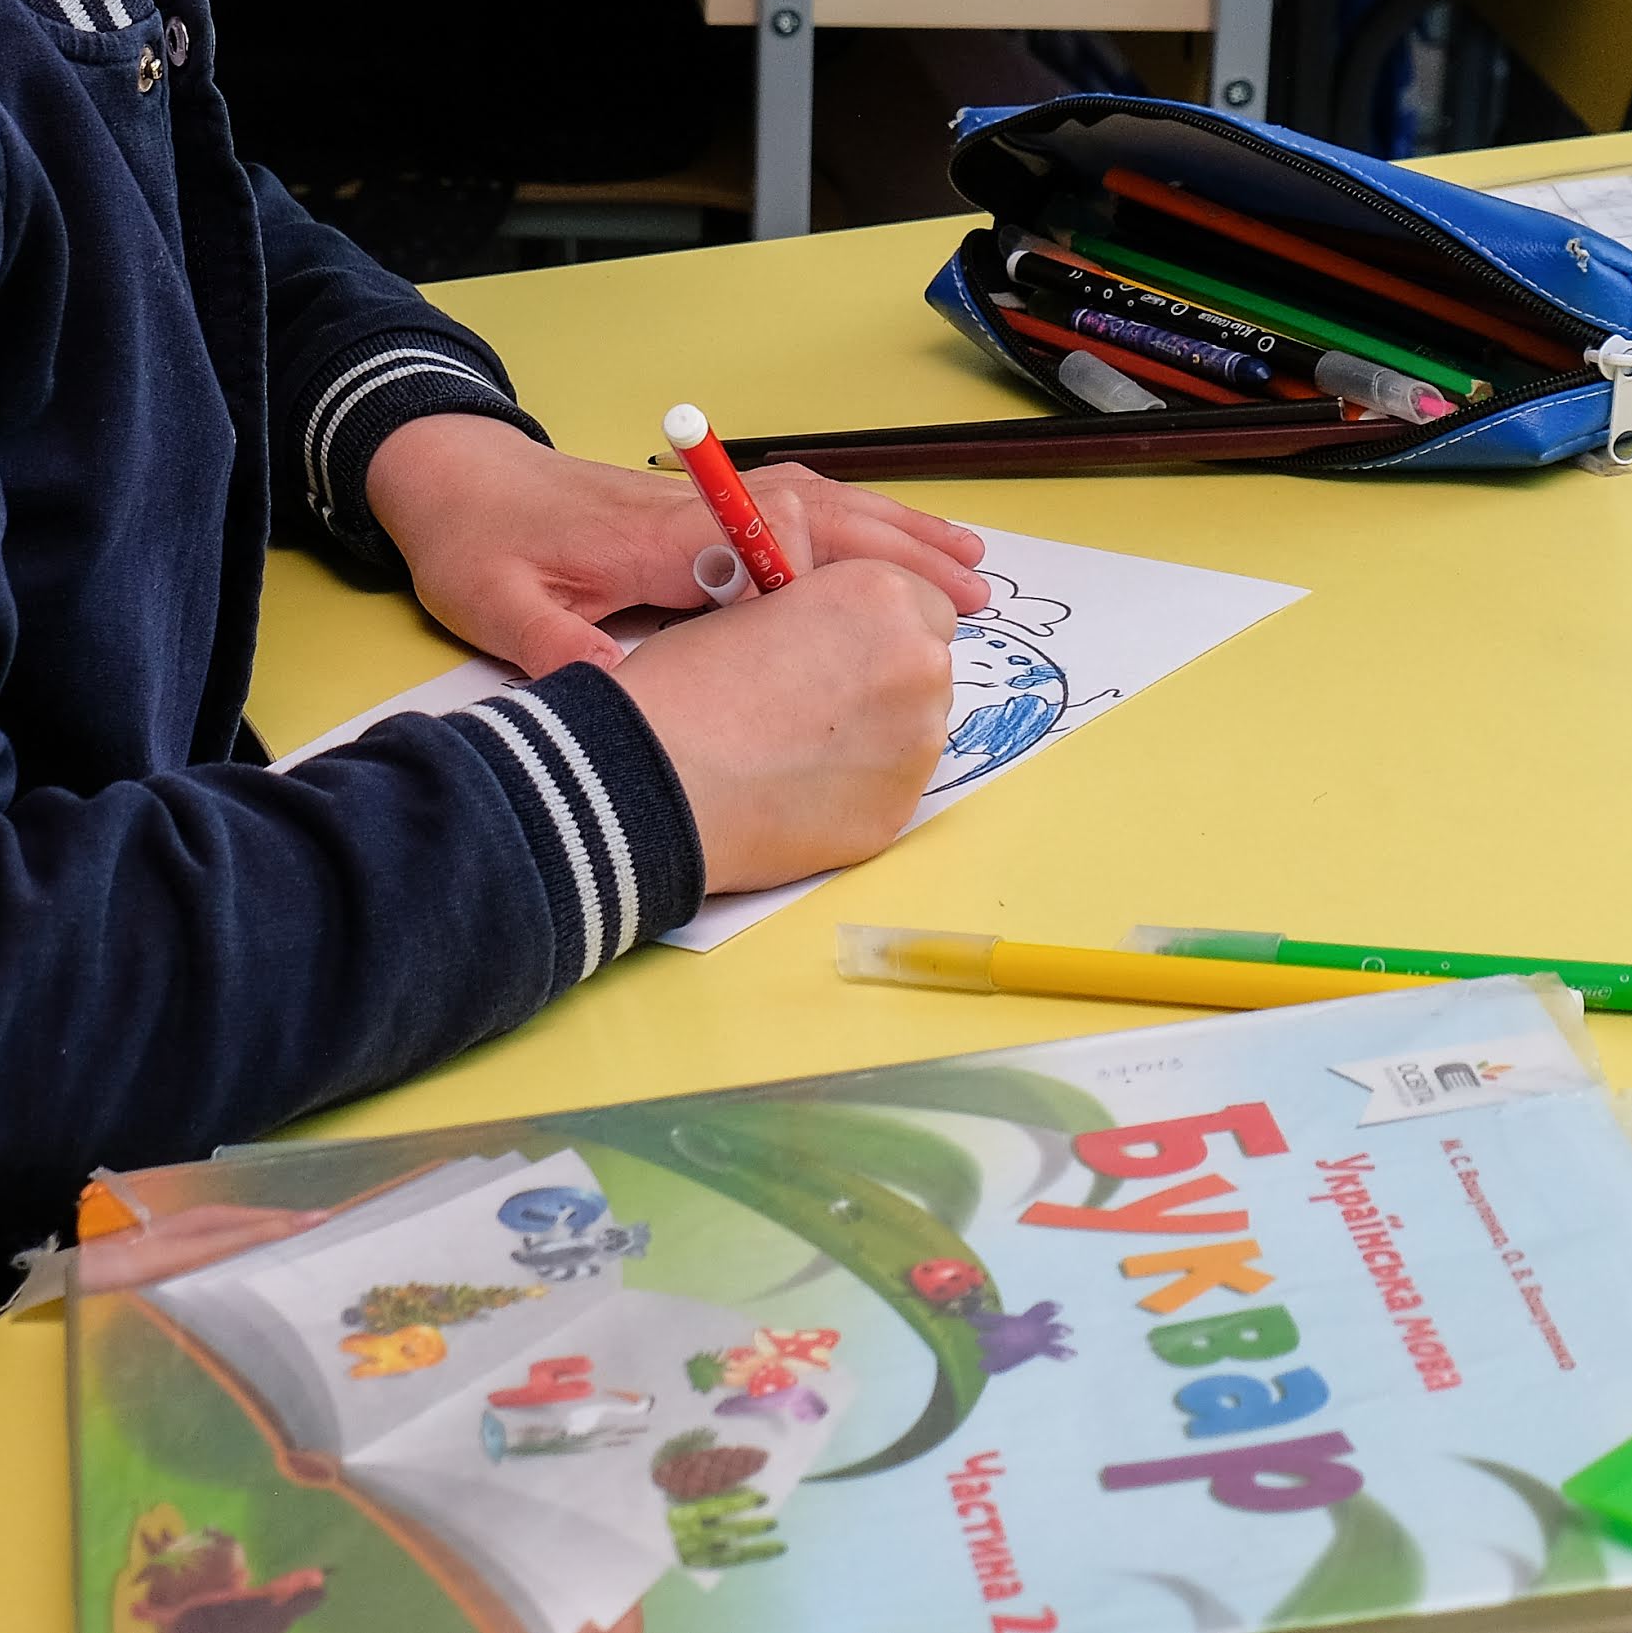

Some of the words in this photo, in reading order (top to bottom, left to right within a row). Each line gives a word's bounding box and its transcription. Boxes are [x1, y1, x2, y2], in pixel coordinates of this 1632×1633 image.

[1017, 1101, 1364, 1514] Буквар
[1309, 1152, 1424, 1312] Українська
[1393, 1317, 1462, 1392] мова
[947, 1449, 1024, 1602] Частина
